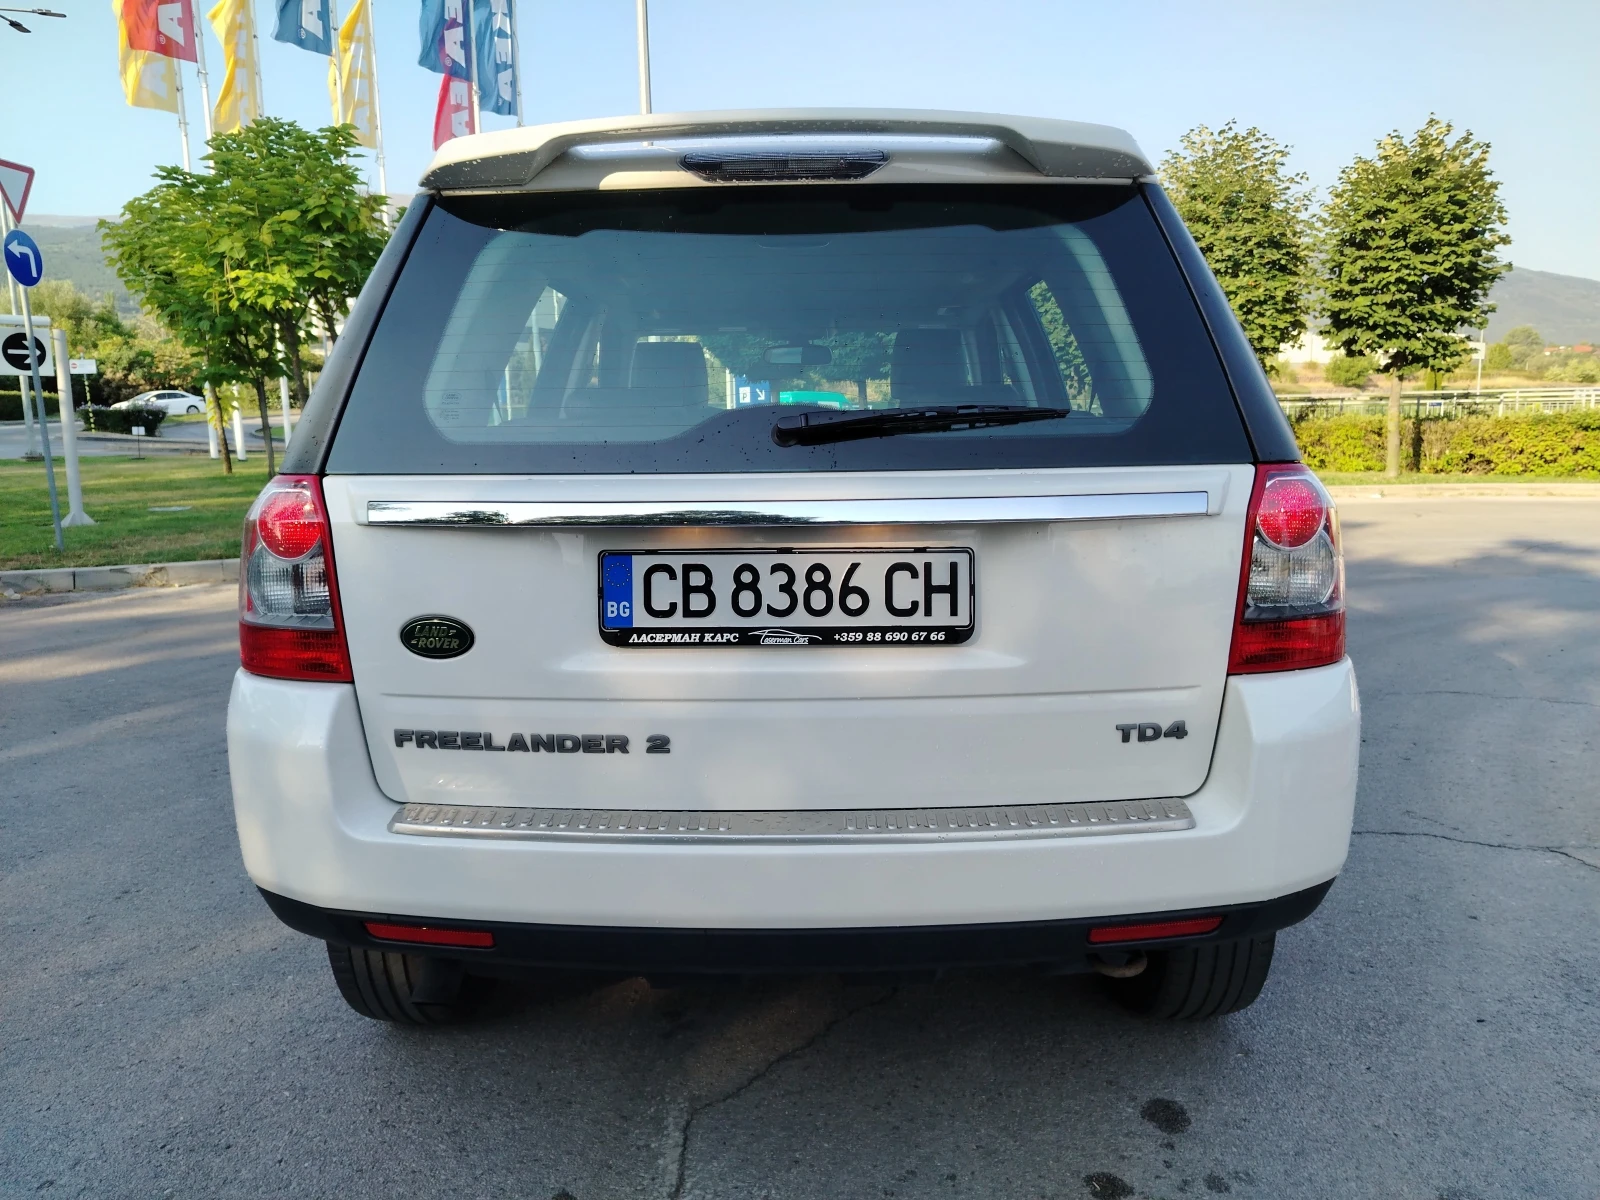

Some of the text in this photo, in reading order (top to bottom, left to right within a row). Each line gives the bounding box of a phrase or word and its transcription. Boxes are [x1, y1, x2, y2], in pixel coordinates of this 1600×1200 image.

[643, 561, 959, 619] CB 8386 CH
[607, 601, 630, 618] BG
[414, 625, 448, 637] LAND
[703, 633, 739, 642] КАРС
[833, 631, 945, 642] +359 88 690 67 66
[418, 637, 460, 649] ROVER
[1115, 719, 1188, 743] TD4
[393, 728, 671, 754] FREELANDER 2
